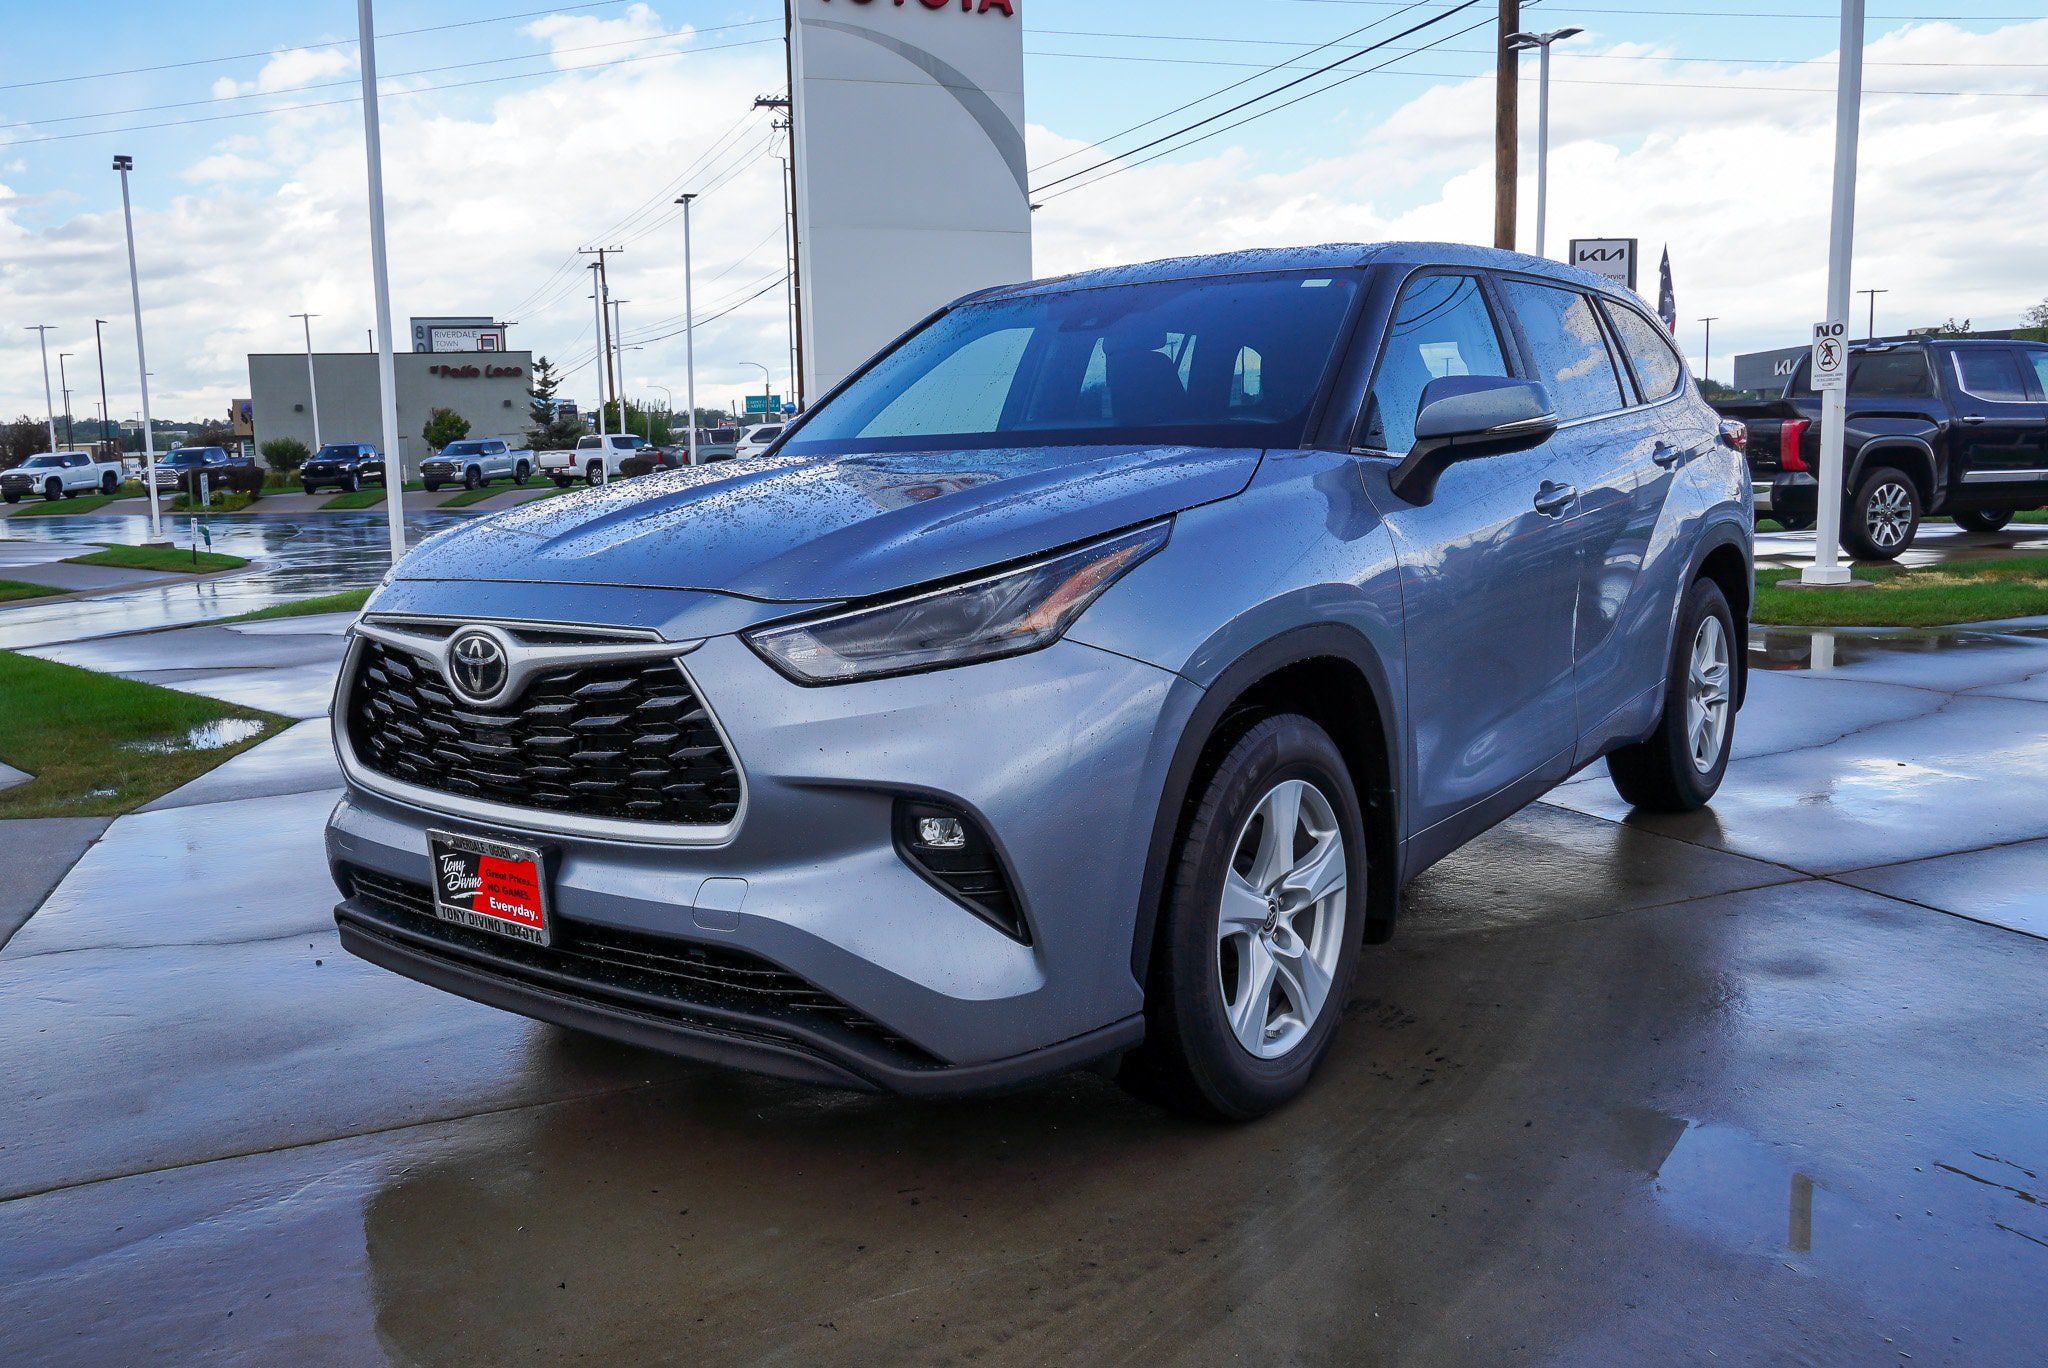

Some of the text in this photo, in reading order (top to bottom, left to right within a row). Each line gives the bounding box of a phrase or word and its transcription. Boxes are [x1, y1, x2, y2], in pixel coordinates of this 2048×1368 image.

[1579, 248, 1625, 261] KIA
[434, 330, 478, 339] RIVERDALE
[1816, 323, 1844, 337] NO
[485, 364, 523, 379] Loco
[1774, 358, 1793, 376] KI
[440, 853, 466, 876] Tony
[485, 868, 507, 880] Great
[443, 872, 484, 892] Divino
[487, 884, 500, 894] NO
[489, 896, 539, 922] Everyday.
[442, 906, 543, 944] TONY DIVINO TOYOTA
